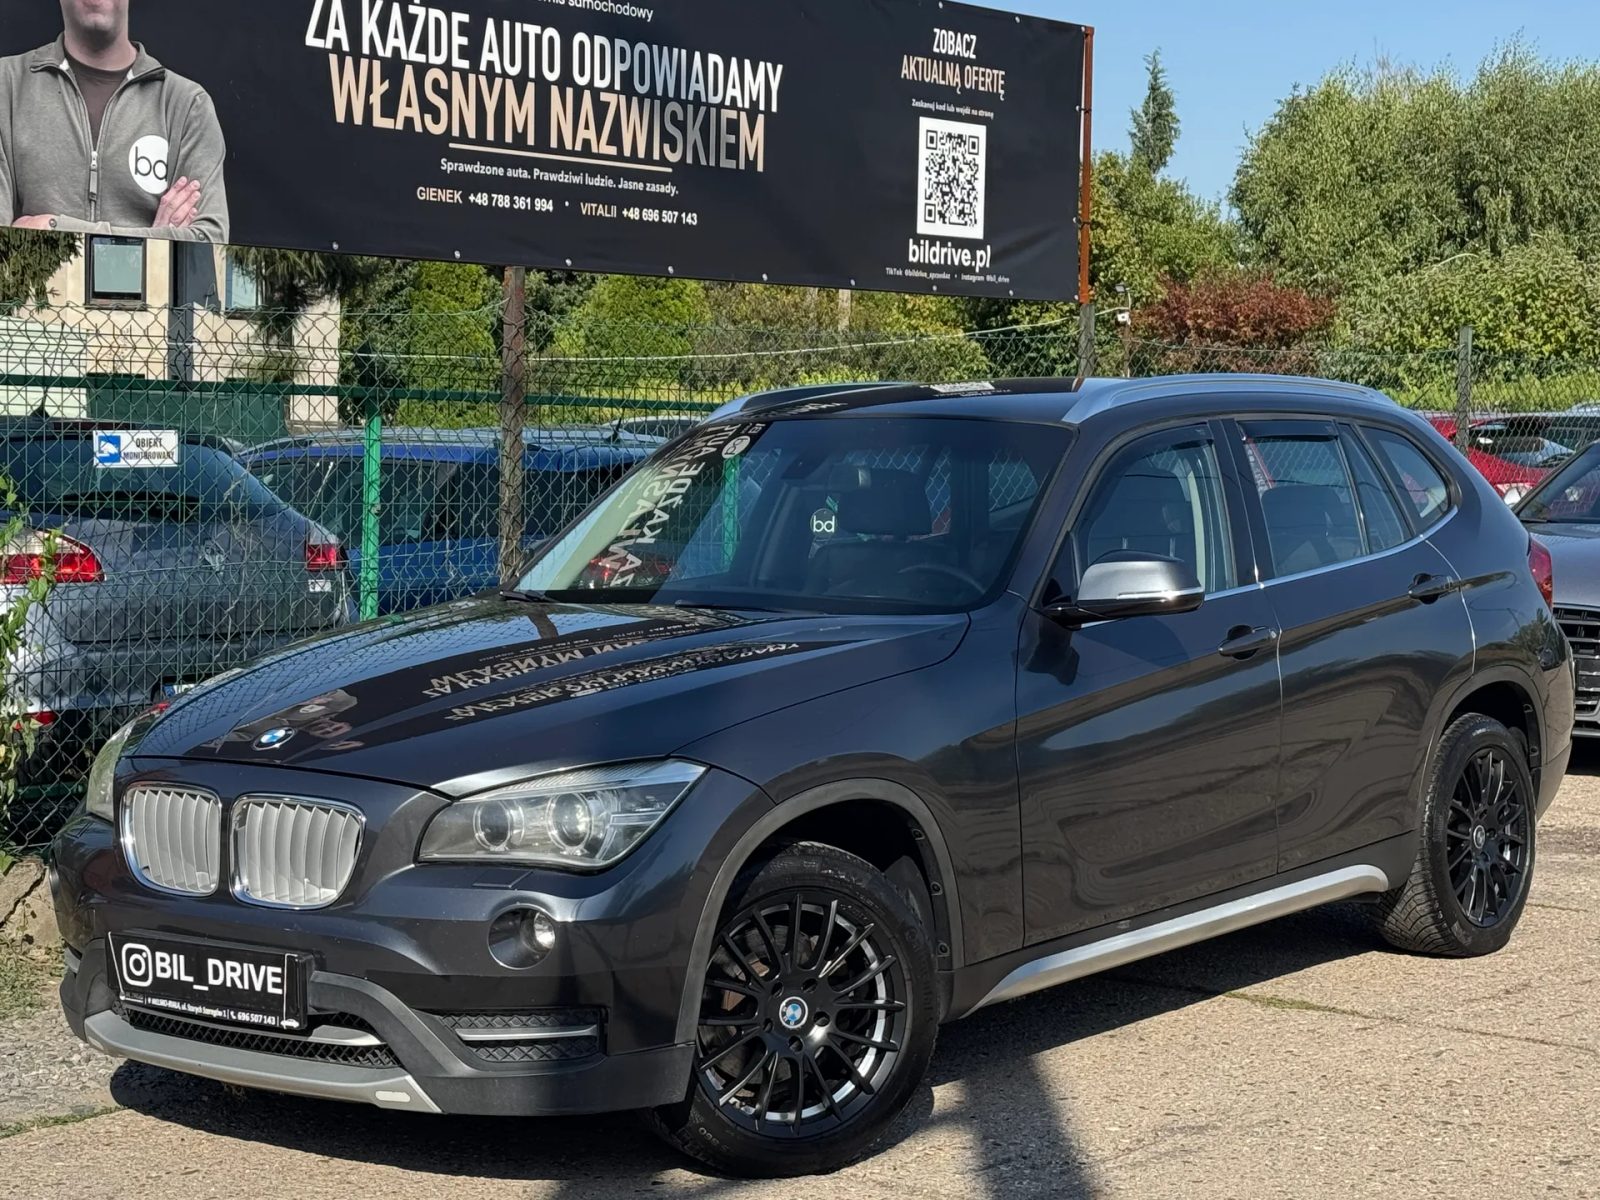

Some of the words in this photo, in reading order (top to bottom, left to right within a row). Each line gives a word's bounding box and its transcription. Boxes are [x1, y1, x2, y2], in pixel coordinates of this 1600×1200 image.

[568, 0, 654, 22] samochodowy
[305, 0, 350, 52] ZA
[362, 0, 470, 69] KAŻDE
[480, 18, 561, 82] AUTO
[572, 31, 784, 113] ODPOWIADAMY
[932, 28, 977, 60] ZOBACZ
[901, 54, 961, 94] AKTUALNĄ
[964, 64, 1005, 101] OFERTĘ
[328, 53, 535, 146] WŁASNYM
[550, 84, 765, 173] NAZWISKIEM
[441, 158, 504, 177] Sprawdzone
[506, 167, 531, 179] auta.
[533, 168, 584, 184] Prawdziwi
[585, 172, 616, 188] ludzie.
[618, 177, 644, 191] Jasne
[646, 181, 679, 197] zasady.
[417, 186, 462, 204] GIENEK
[469, 192, 489, 207] +48
[491, 193, 511, 209] 788
[512, 195, 531, 211] 361
[534, 197, 553, 213] 994
[580, 202, 617, 218] VITALII
[622, 206, 640, 221] +48
[641, 207, 660, 222] 696
[662, 209, 679, 224] 507
[681, 211, 697, 226] 143
[908, 238, 991, 273] bildrive.pl
[135, 437, 162, 448] OBIEKT
[813, 515, 835, 533] bd
[155, 951, 283, 995] BIL_DRIVE
[238, 1011, 250, 1021] 696
[250, 1013, 263, 1023] 507
[263, 1014, 275, 1025] 143
